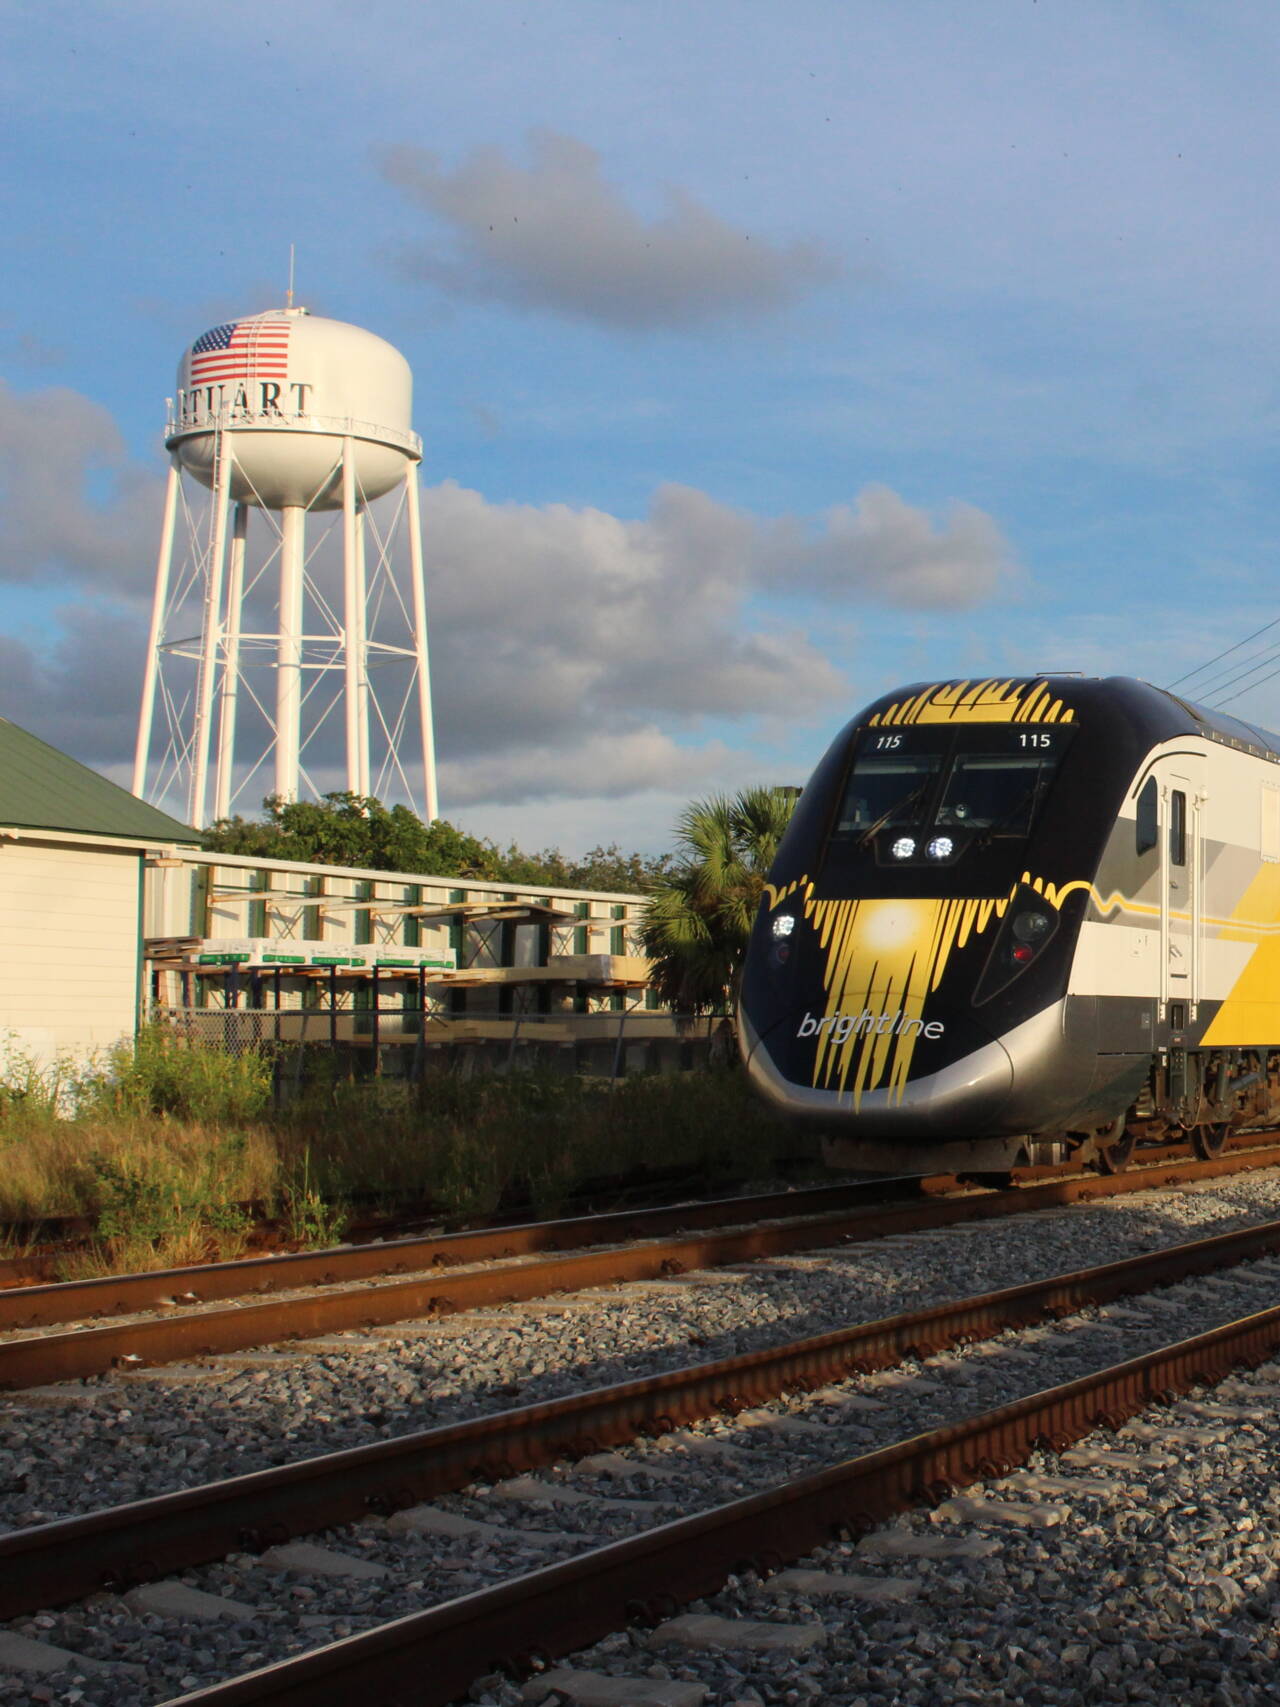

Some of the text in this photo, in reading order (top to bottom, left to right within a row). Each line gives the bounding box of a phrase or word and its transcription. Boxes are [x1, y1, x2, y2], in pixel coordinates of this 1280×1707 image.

[876, 735, 902, 749] 115
[1019, 734, 1051, 747] 115
[796, 1008, 945, 1044] brightline
